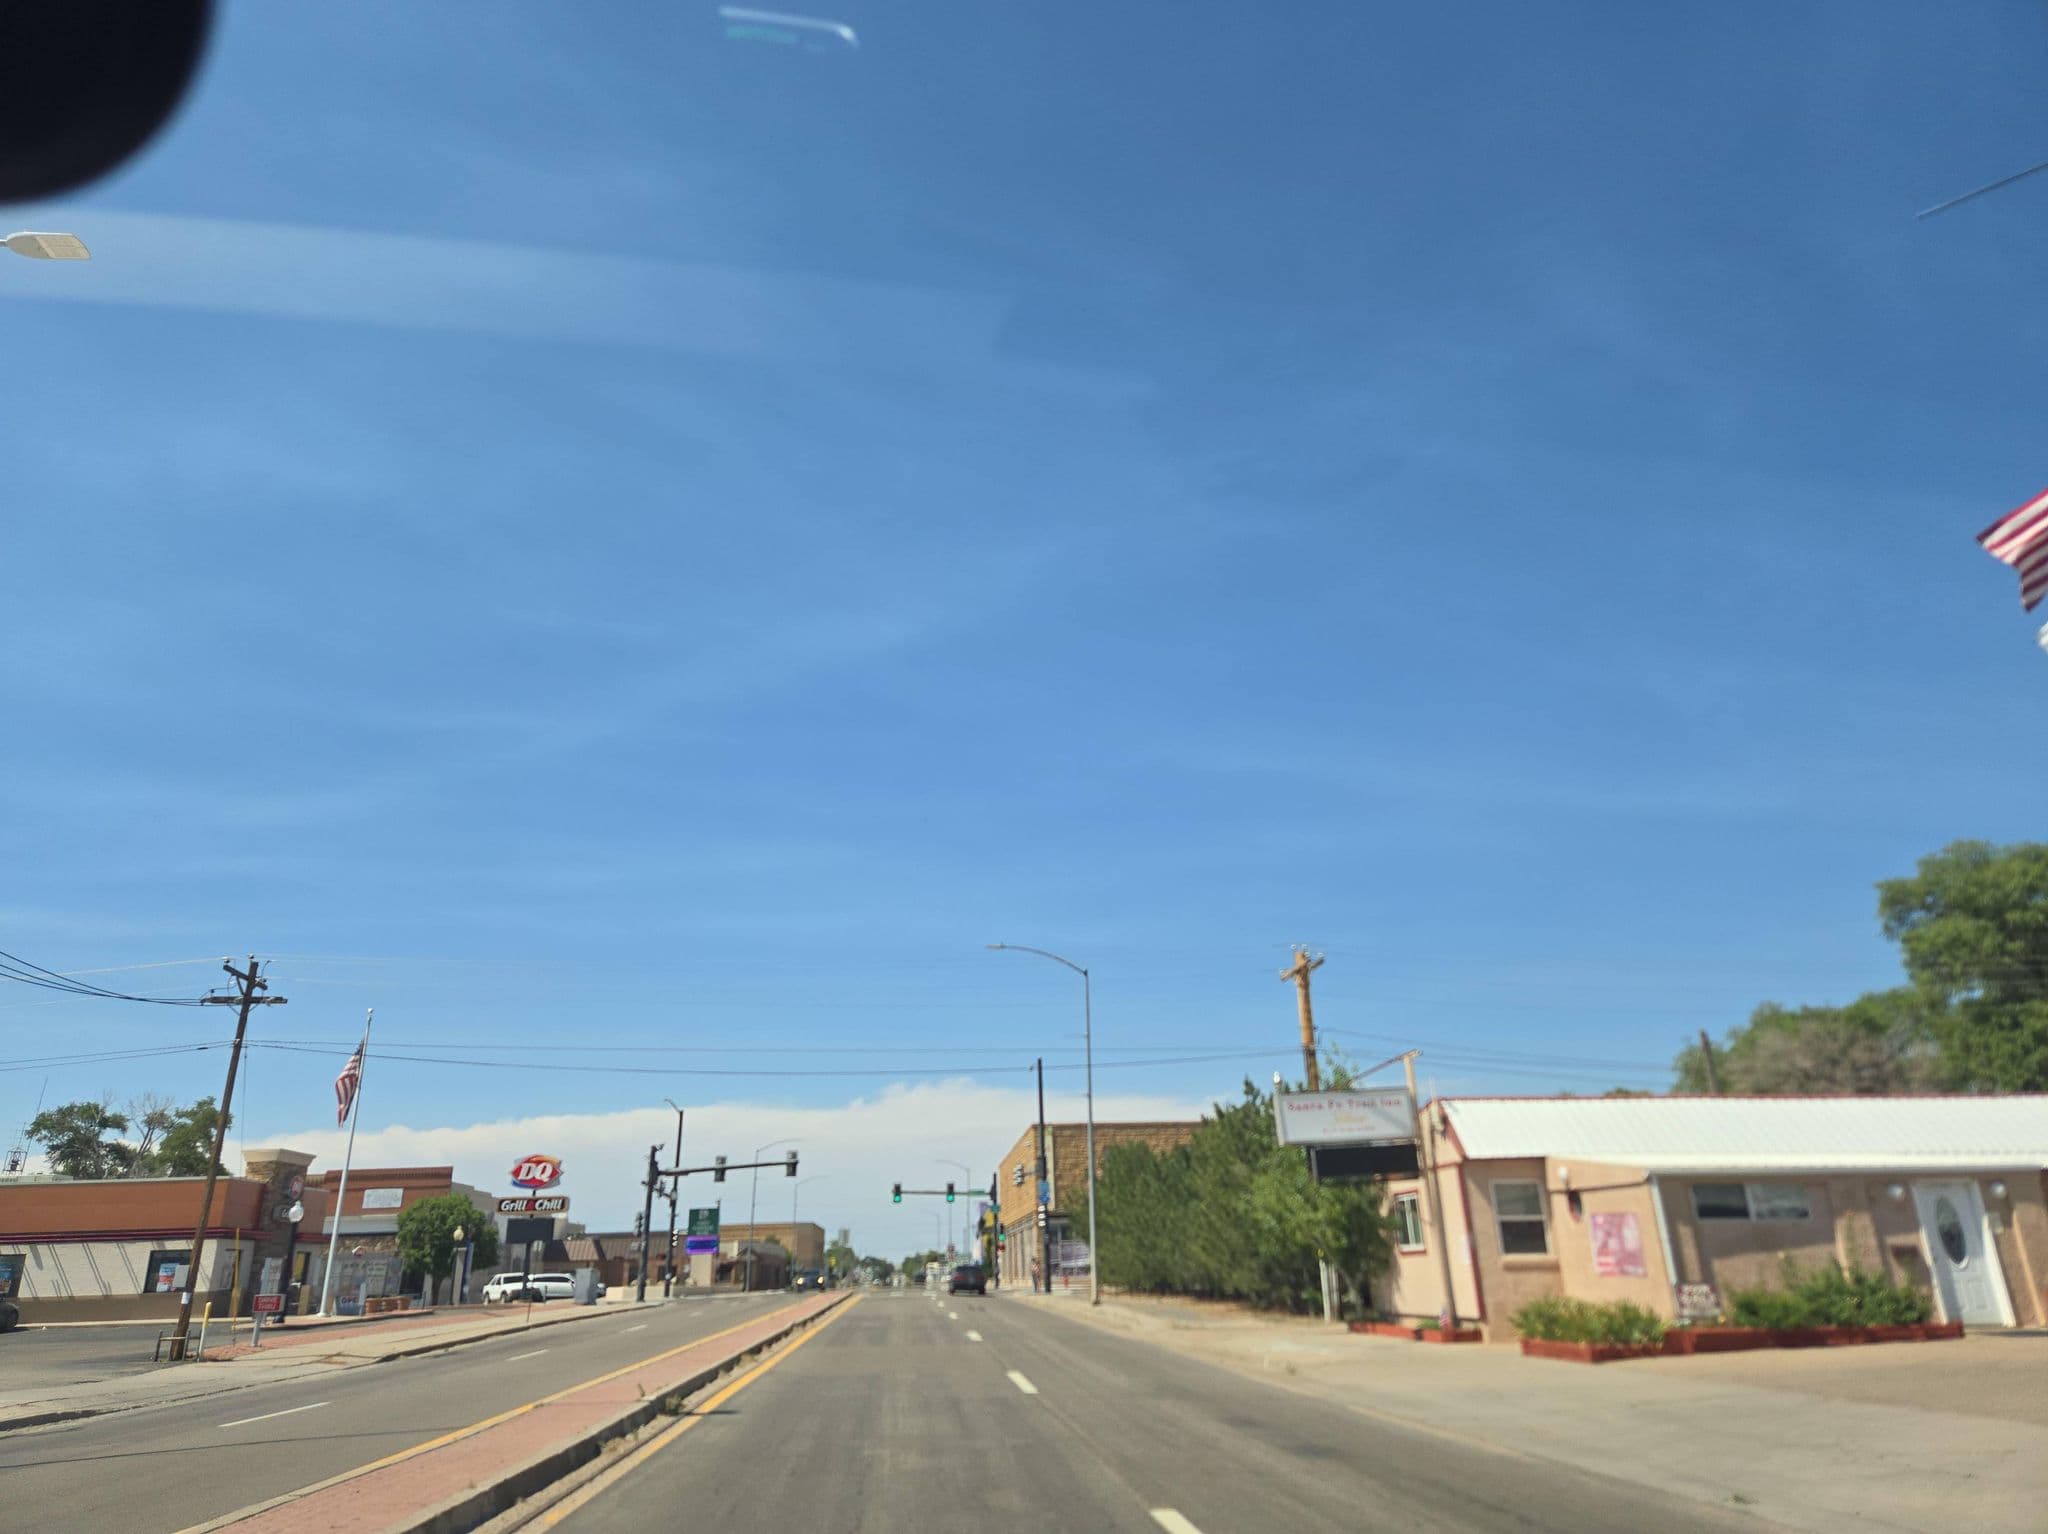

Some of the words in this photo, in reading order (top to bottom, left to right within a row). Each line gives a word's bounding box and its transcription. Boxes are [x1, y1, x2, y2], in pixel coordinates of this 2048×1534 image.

[518, 1161, 553, 1182] DQ
[501, 1200, 527, 1212] Grill
[535, 1199, 563, 1211] Chill
